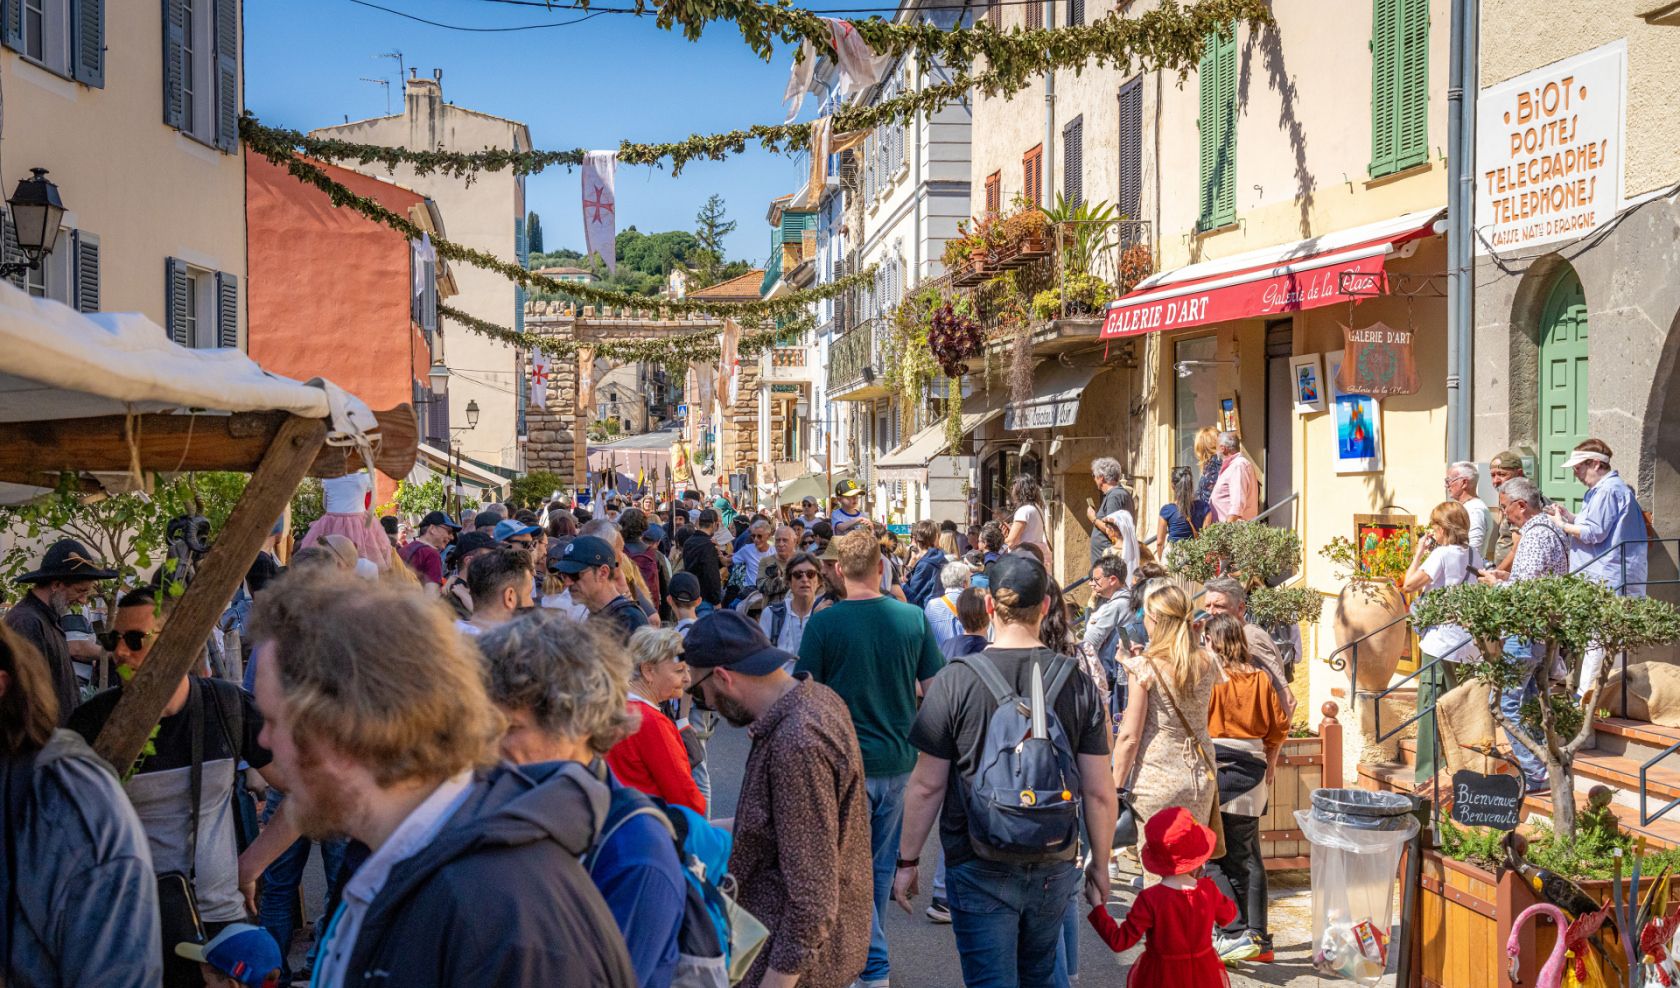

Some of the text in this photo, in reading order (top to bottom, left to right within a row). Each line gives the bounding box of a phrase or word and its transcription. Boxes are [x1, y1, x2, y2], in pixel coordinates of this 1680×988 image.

[1511, 114, 1578, 159] POSTES
[1485, 139, 1607, 196] TELEGRAPHES
[1492, 176, 1596, 224] TELEPHONES
[1261, 280, 1305, 312] Galerie
[1307, 274, 1319, 300] de
[1321, 271, 1333, 297] la
[1106, 296, 1209, 334] GALERIE D'ART
[1348, 331, 1411, 345] GALERIE D'ART
[1457, 783, 1517, 807] Bienvenue
[1459, 804, 1517, 824] Benvenuti
